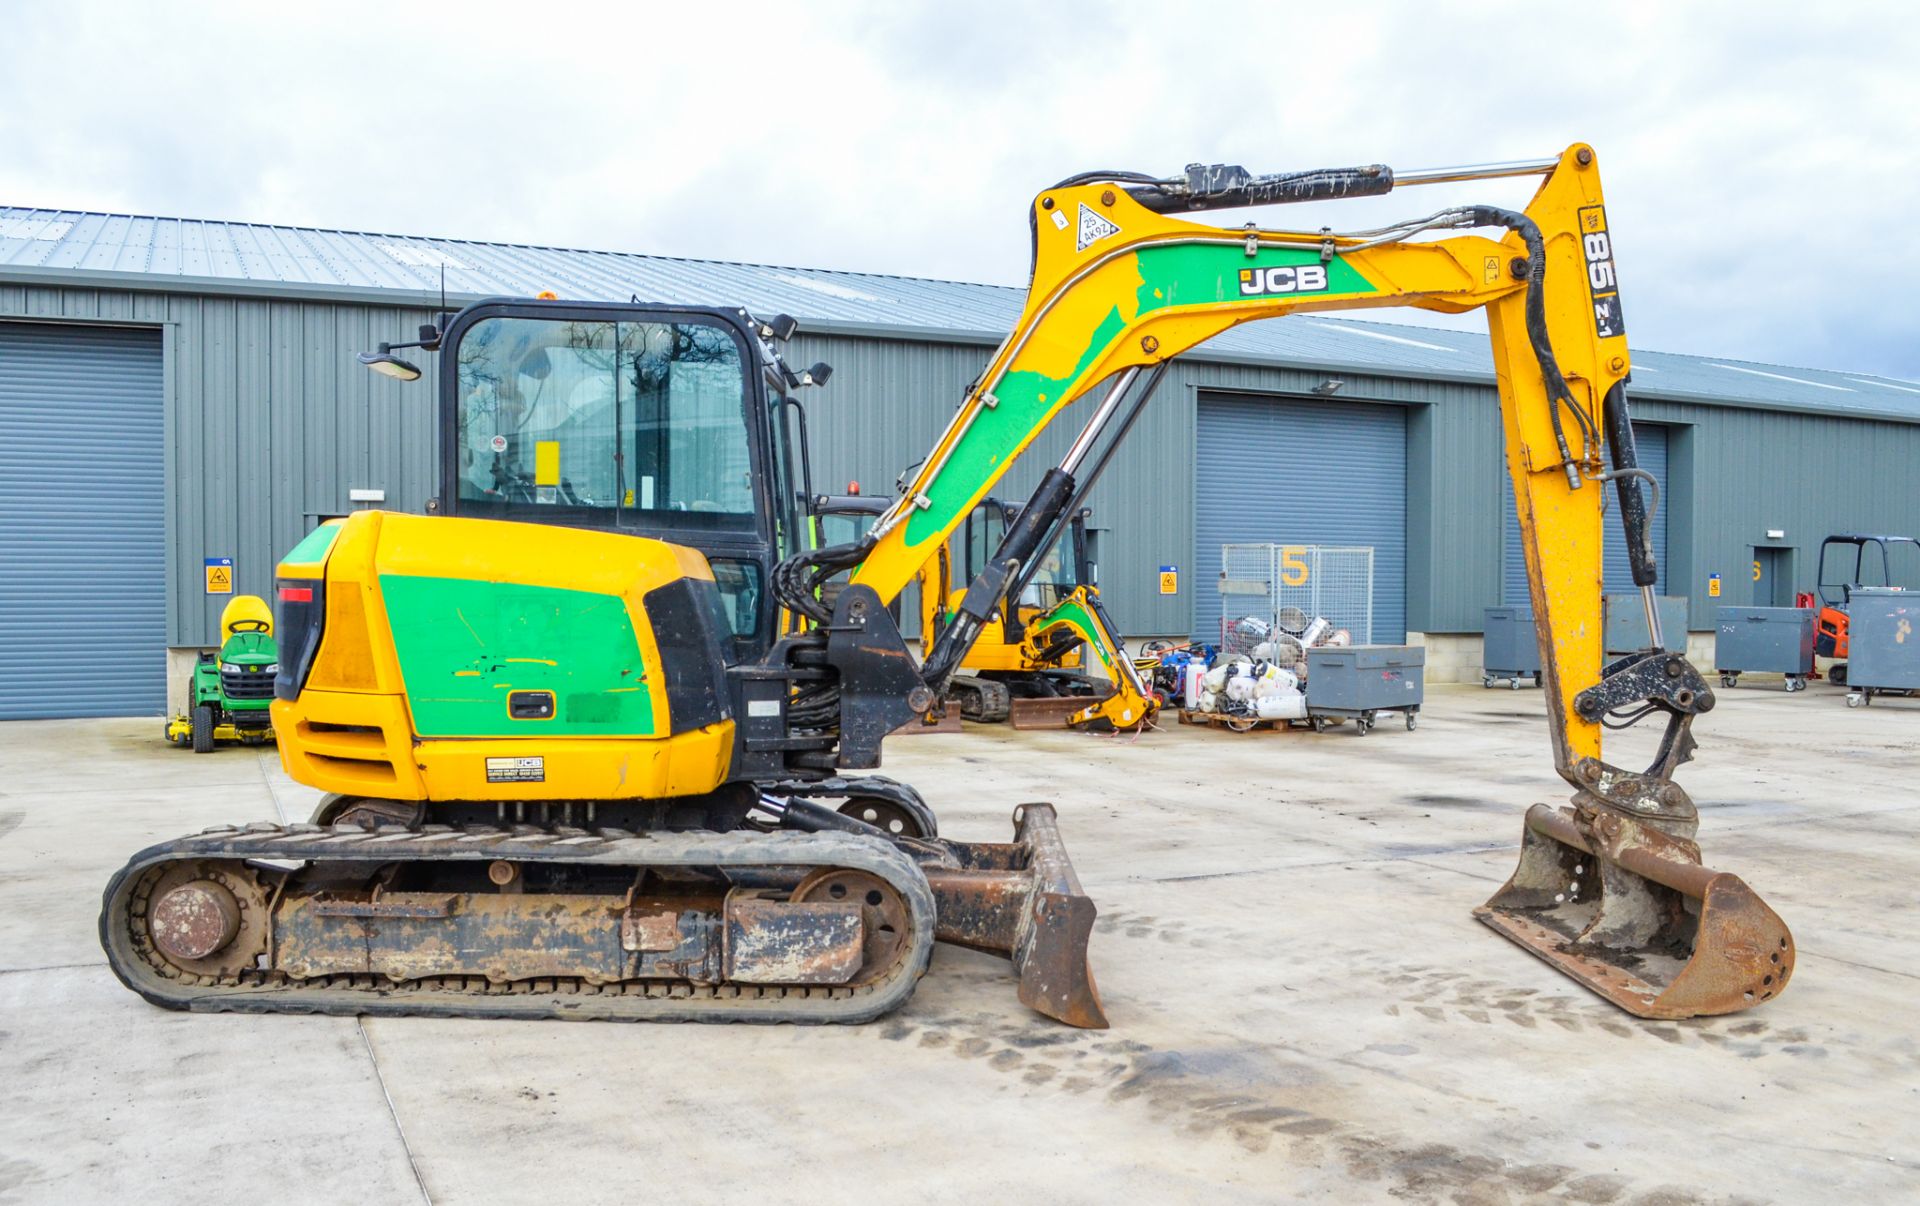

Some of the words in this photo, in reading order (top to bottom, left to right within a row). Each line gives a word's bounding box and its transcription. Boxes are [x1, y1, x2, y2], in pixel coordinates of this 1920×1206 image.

[1084, 216, 1097, 229] 25
[1084, 223, 1109, 241] AK9Z
[1583, 232, 1615, 289] 85
[1240, 265, 1327, 295] JCB
[1282, 546, 1309, 586] 5
